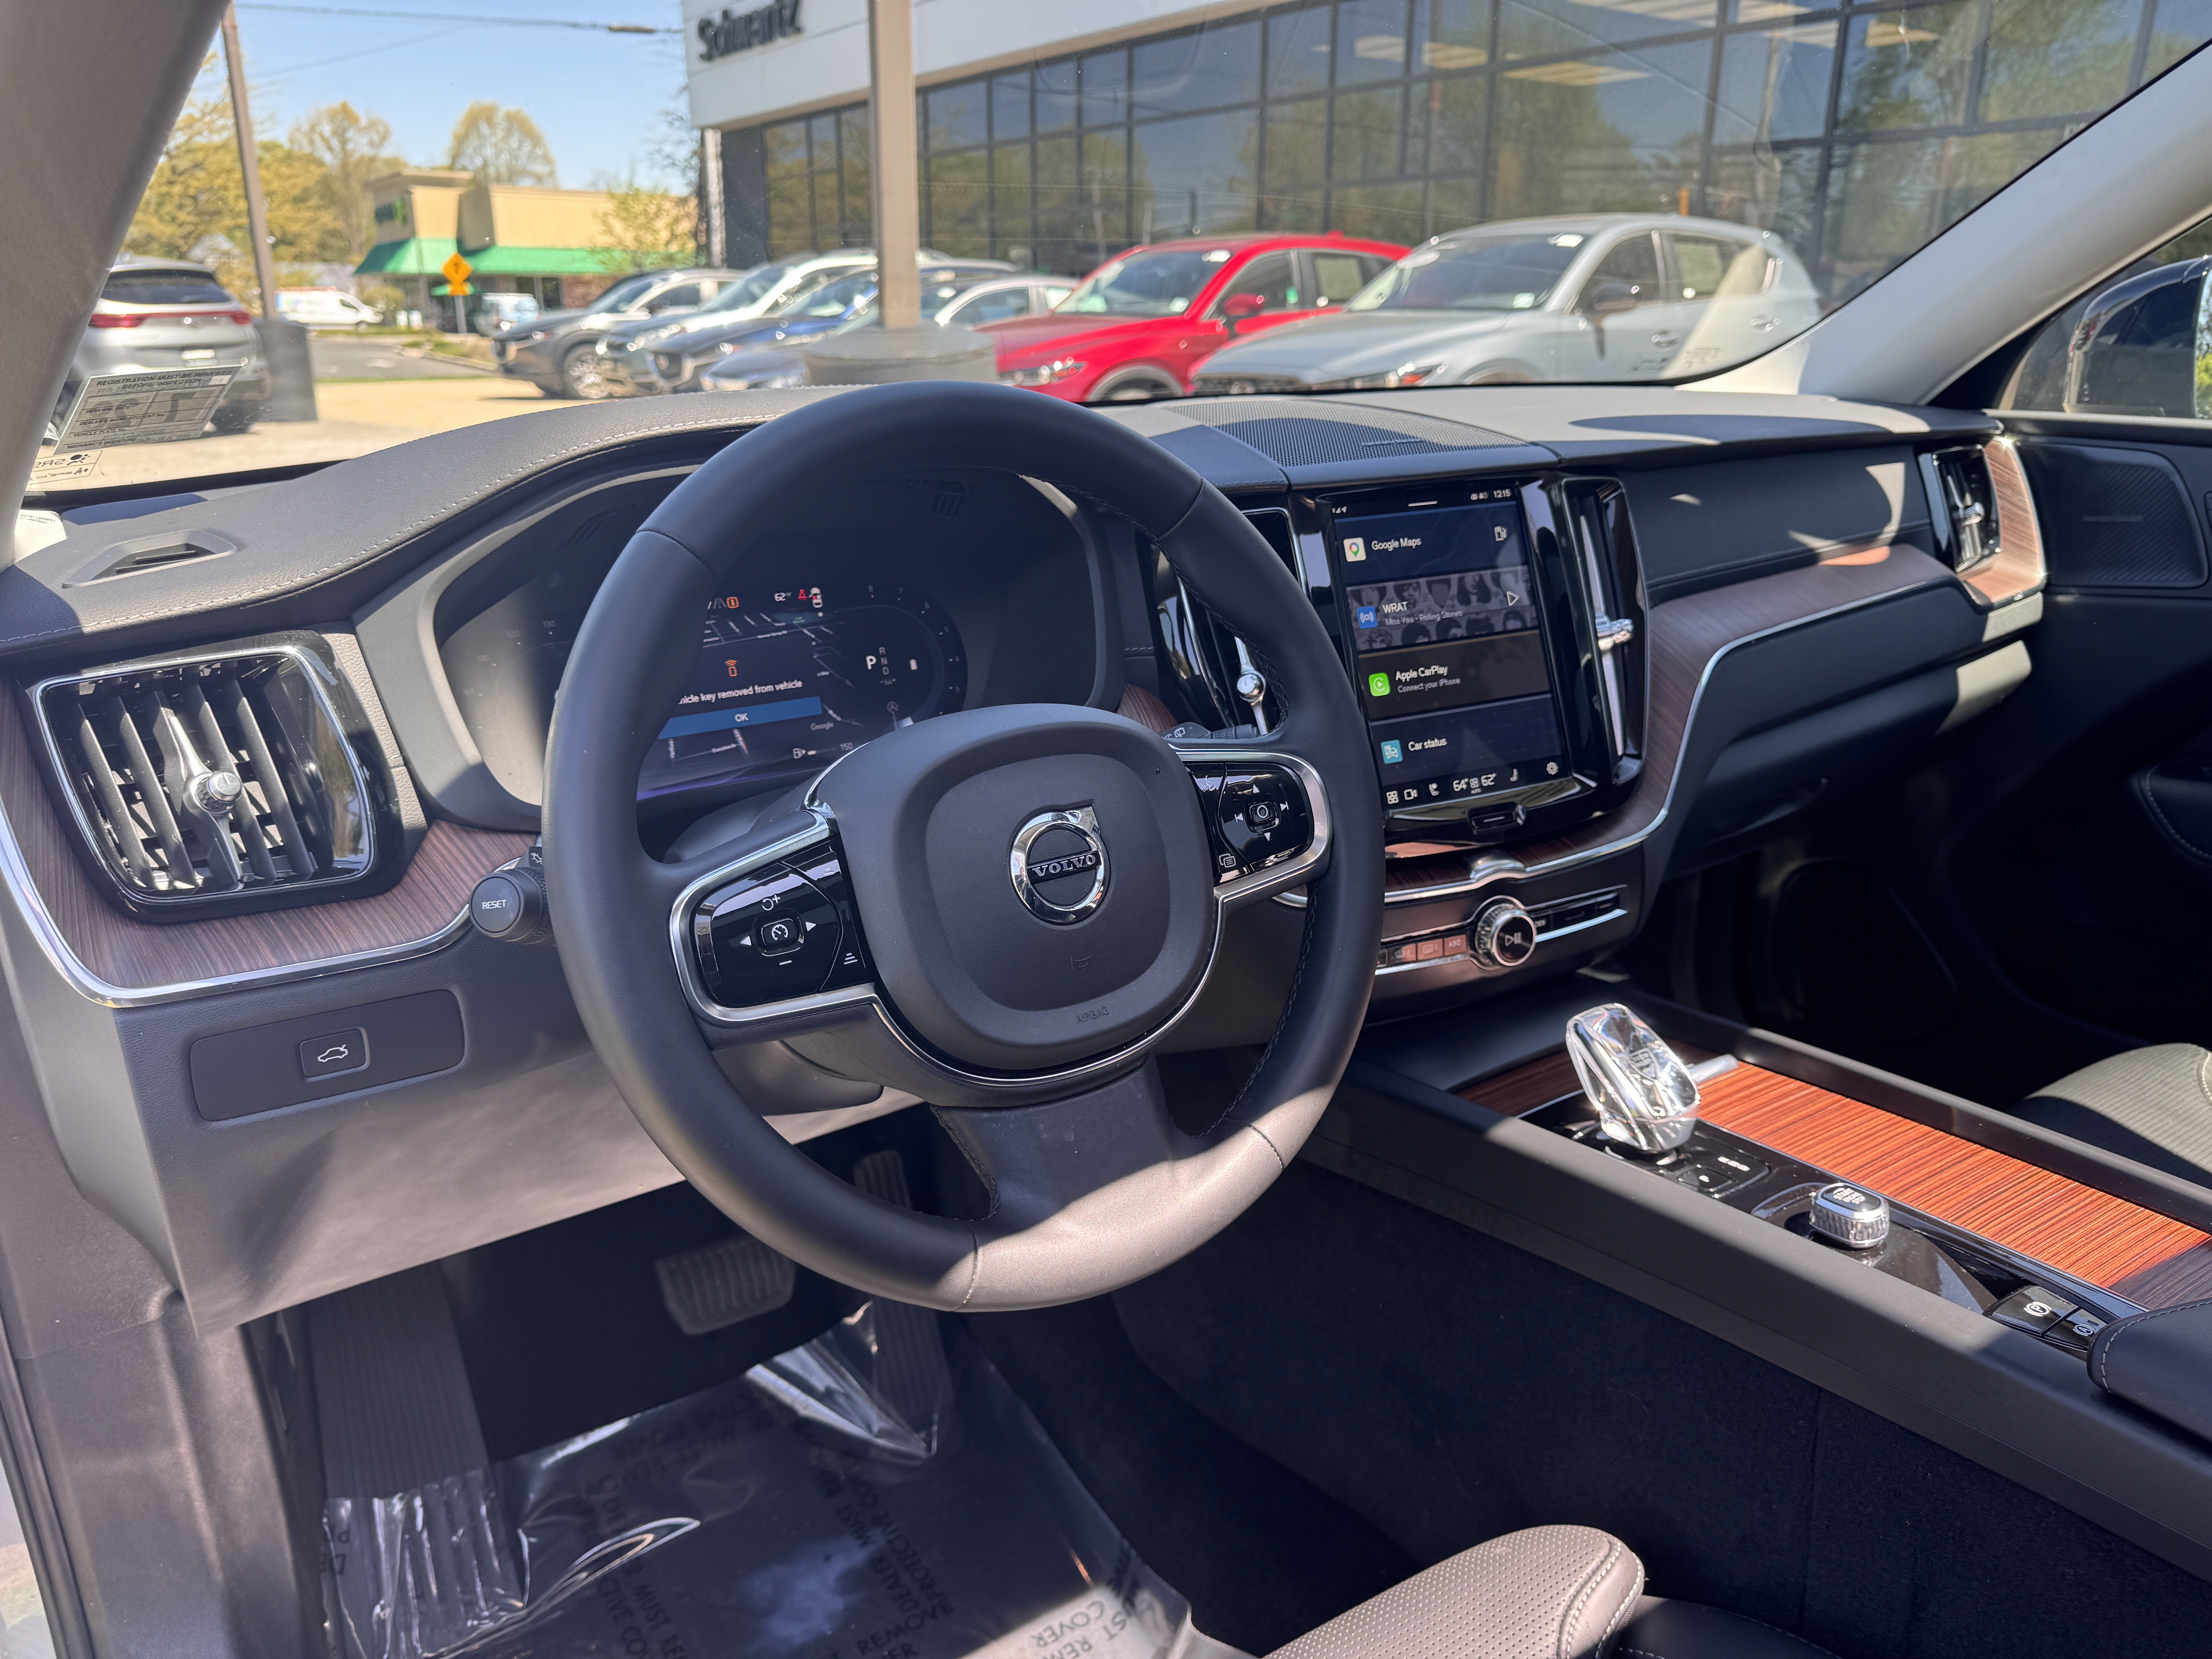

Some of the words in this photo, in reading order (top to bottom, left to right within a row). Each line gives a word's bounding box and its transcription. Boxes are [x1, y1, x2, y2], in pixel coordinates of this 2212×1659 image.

[97, 377, 155, 386] REGISTRATION
[1371, 538, 1400, 551] Google
[1400, 537, 1422, 548] Maps
[1382, 601, 1409, 613] WRAT
[879, 647, 886, 655] R
[866, 655, 877, 670] P
[883, 667, 890, 675] D
[1396, 669, 1418, 682] Apple
[1418, 665, 1449, 677] CarPlay
[700, 693, 716, 703] key
[717, 685, 754, 699] removed
[754, 684, 774, 694] from
[775, 679, 803, 690] vehicle
[1397, 682, 1424, 693] Connect
[1424, 681, 1438, 691] your
[1438, 678, 1462, 687] iPhone
[734, 713, 749, 723] OK
[810, 721, 834, 730] Google
[1408, 740, 1423, 751] Car
[1423, 737, 1448, 749] status
[1032, 854, 1096, 877] VOLVO
[482, 899, 507, 910] RESET
[1076, 1006, 1111, 1024] AIRBAG
[835, 1503, 874, 1548] MUST
[869, 1510, 945, 1602] PROTECTIVE
[867, 1553, 921, 1615] DEALER
[631, 1581, 673, 1630] MUST
[854, 1595, 956, 1657] REMOVE
[1029, 1600, 1106, 1650] COVER
